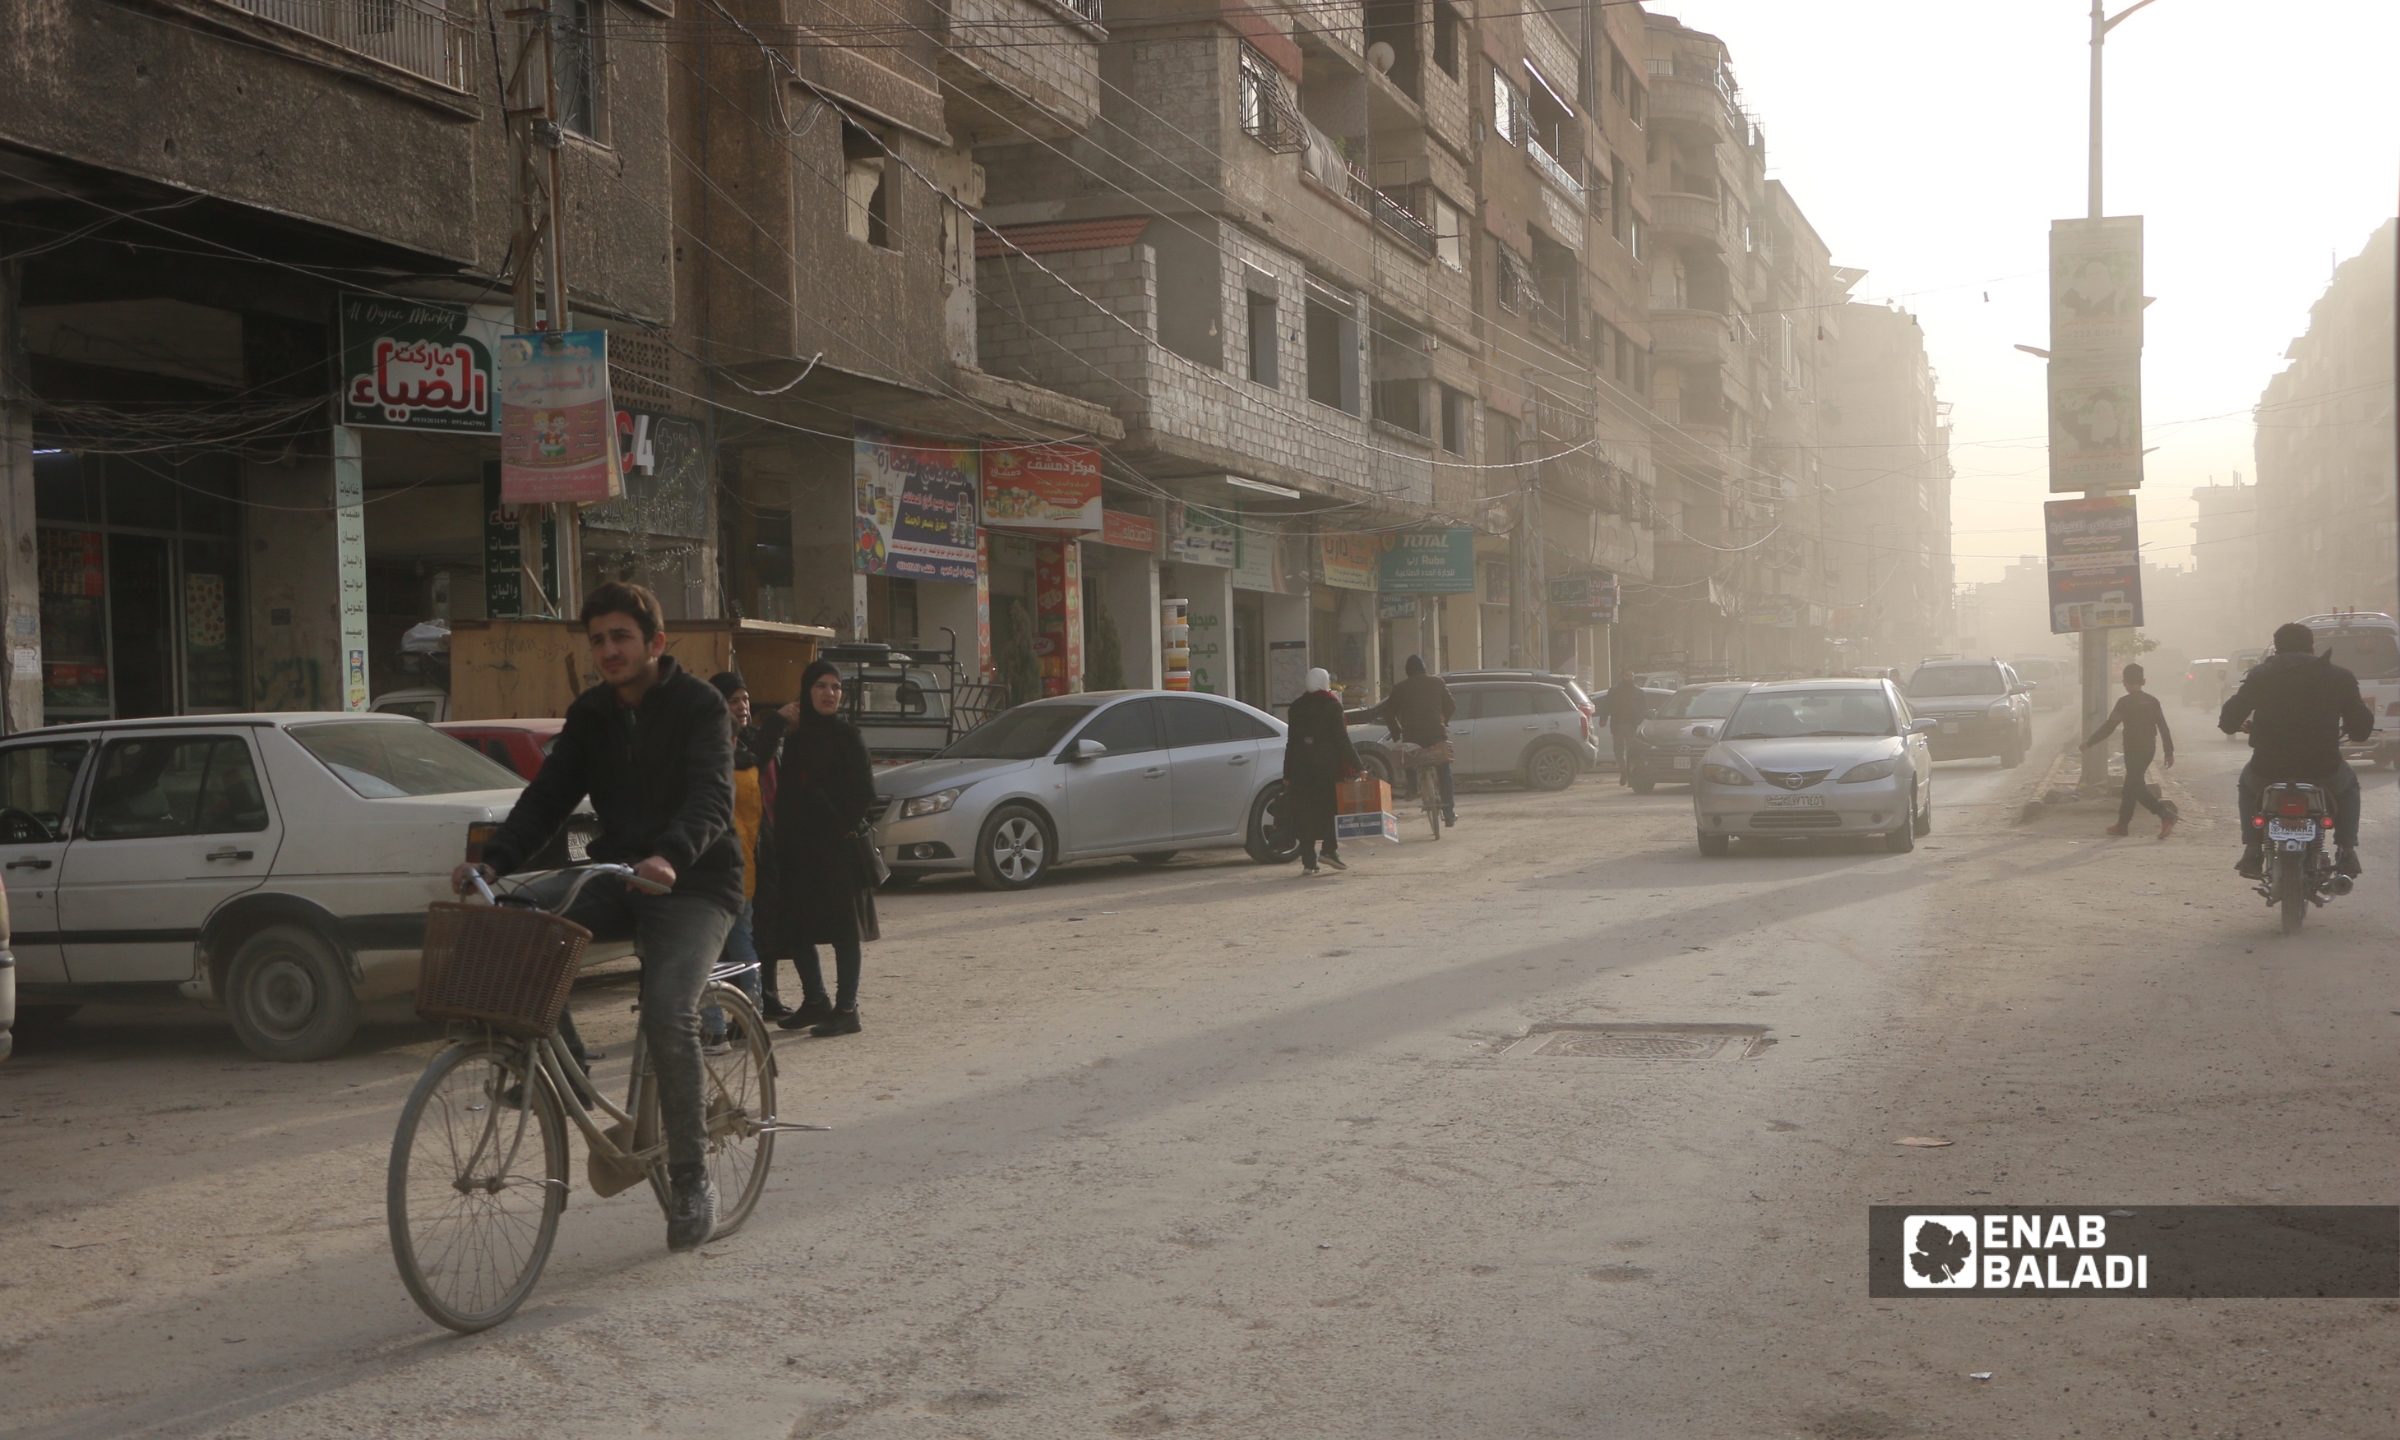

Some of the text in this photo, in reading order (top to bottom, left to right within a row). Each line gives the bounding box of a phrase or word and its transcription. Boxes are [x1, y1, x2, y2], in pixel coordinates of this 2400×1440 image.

[347, 302, 361, 321] Al
[409, 308, 456, 330] Market
[395, 344, 454, 370] ماركت
[352, 342, 485, 419] الضياء
[1027, 454, 1096, 476] مركز دمشق
[2050, 516, 2133, 535] الخولاني للتجارة
[1402, 534, 1449, 548] TOTAL
[1421, 555, 1446, 565] Ruba
